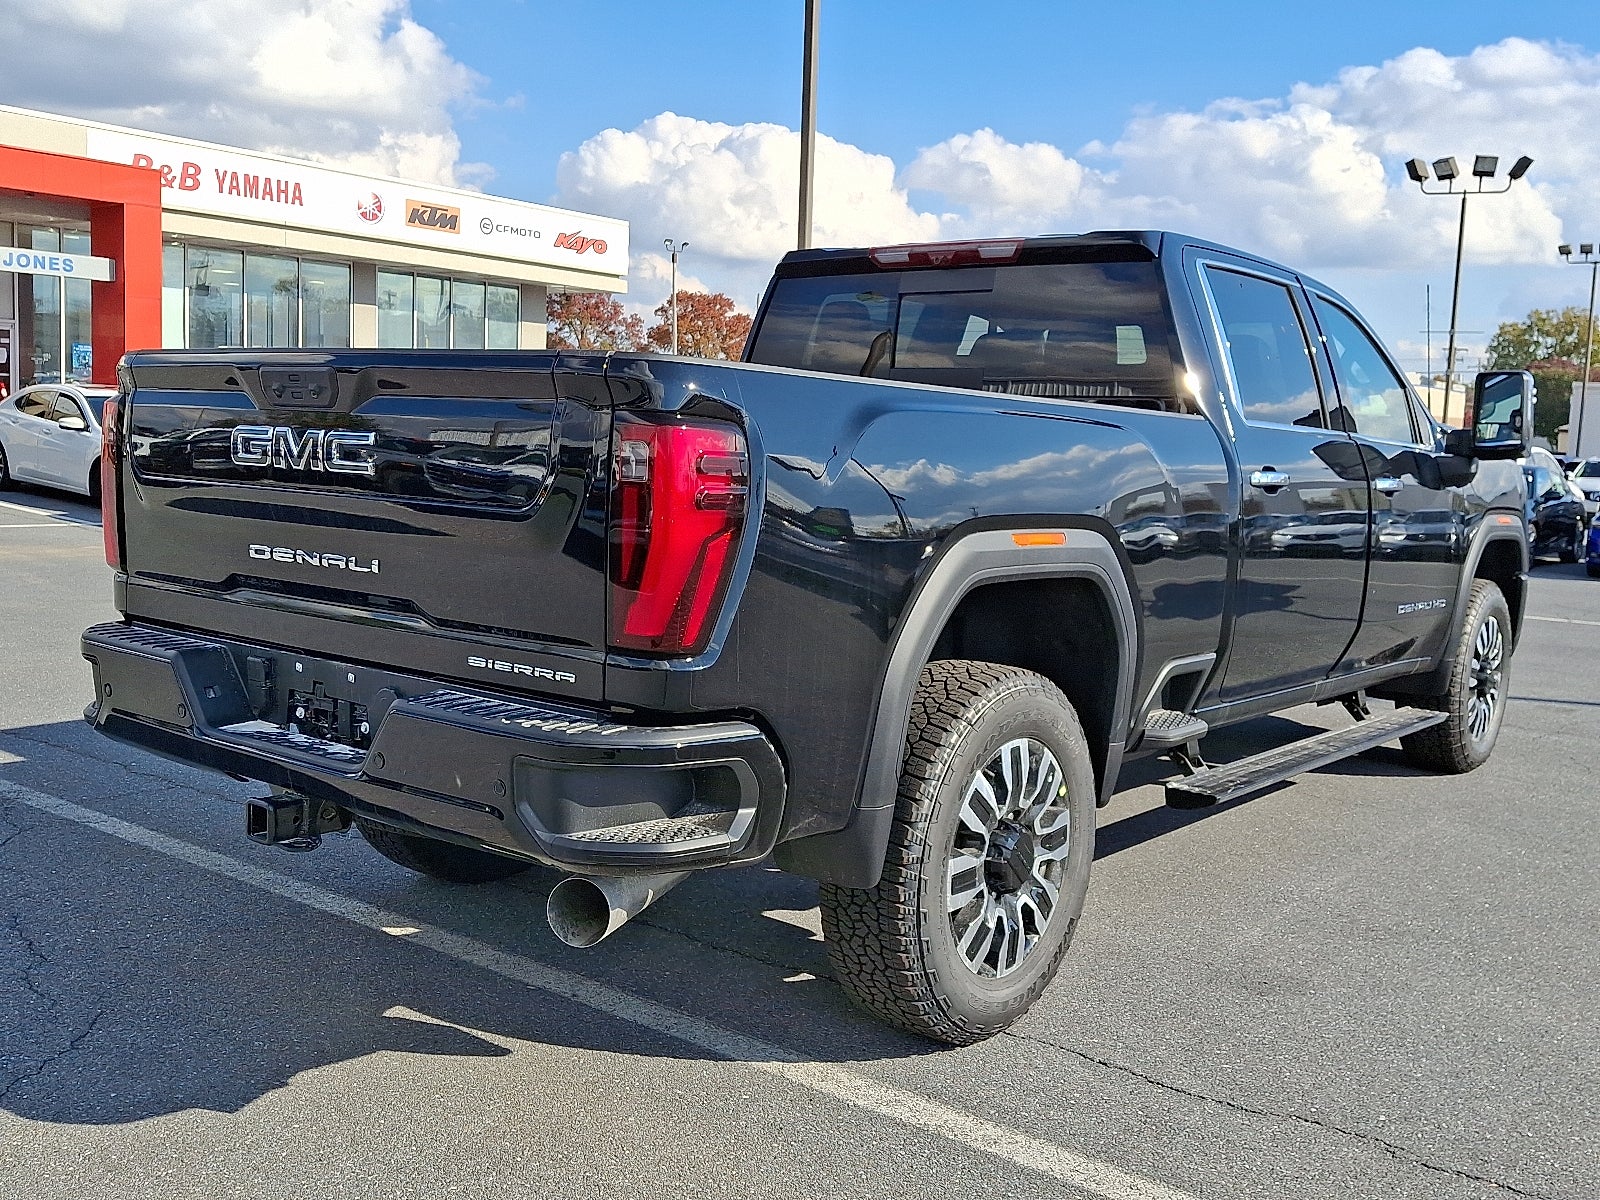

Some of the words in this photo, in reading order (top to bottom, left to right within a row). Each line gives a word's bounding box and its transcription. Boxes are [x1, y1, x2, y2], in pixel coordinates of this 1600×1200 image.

[215, 168, 304, 207] YAMAHA
[408, 204, 459, 232] KTM
[495, 223, 541, 239] CFMOTO
[2, 252, 75, 273] JONES
[230, 424, 379, 477] GMC
[248, 543, 381, 574] DENALI
[466, 655, 577, 684] SIERRA
